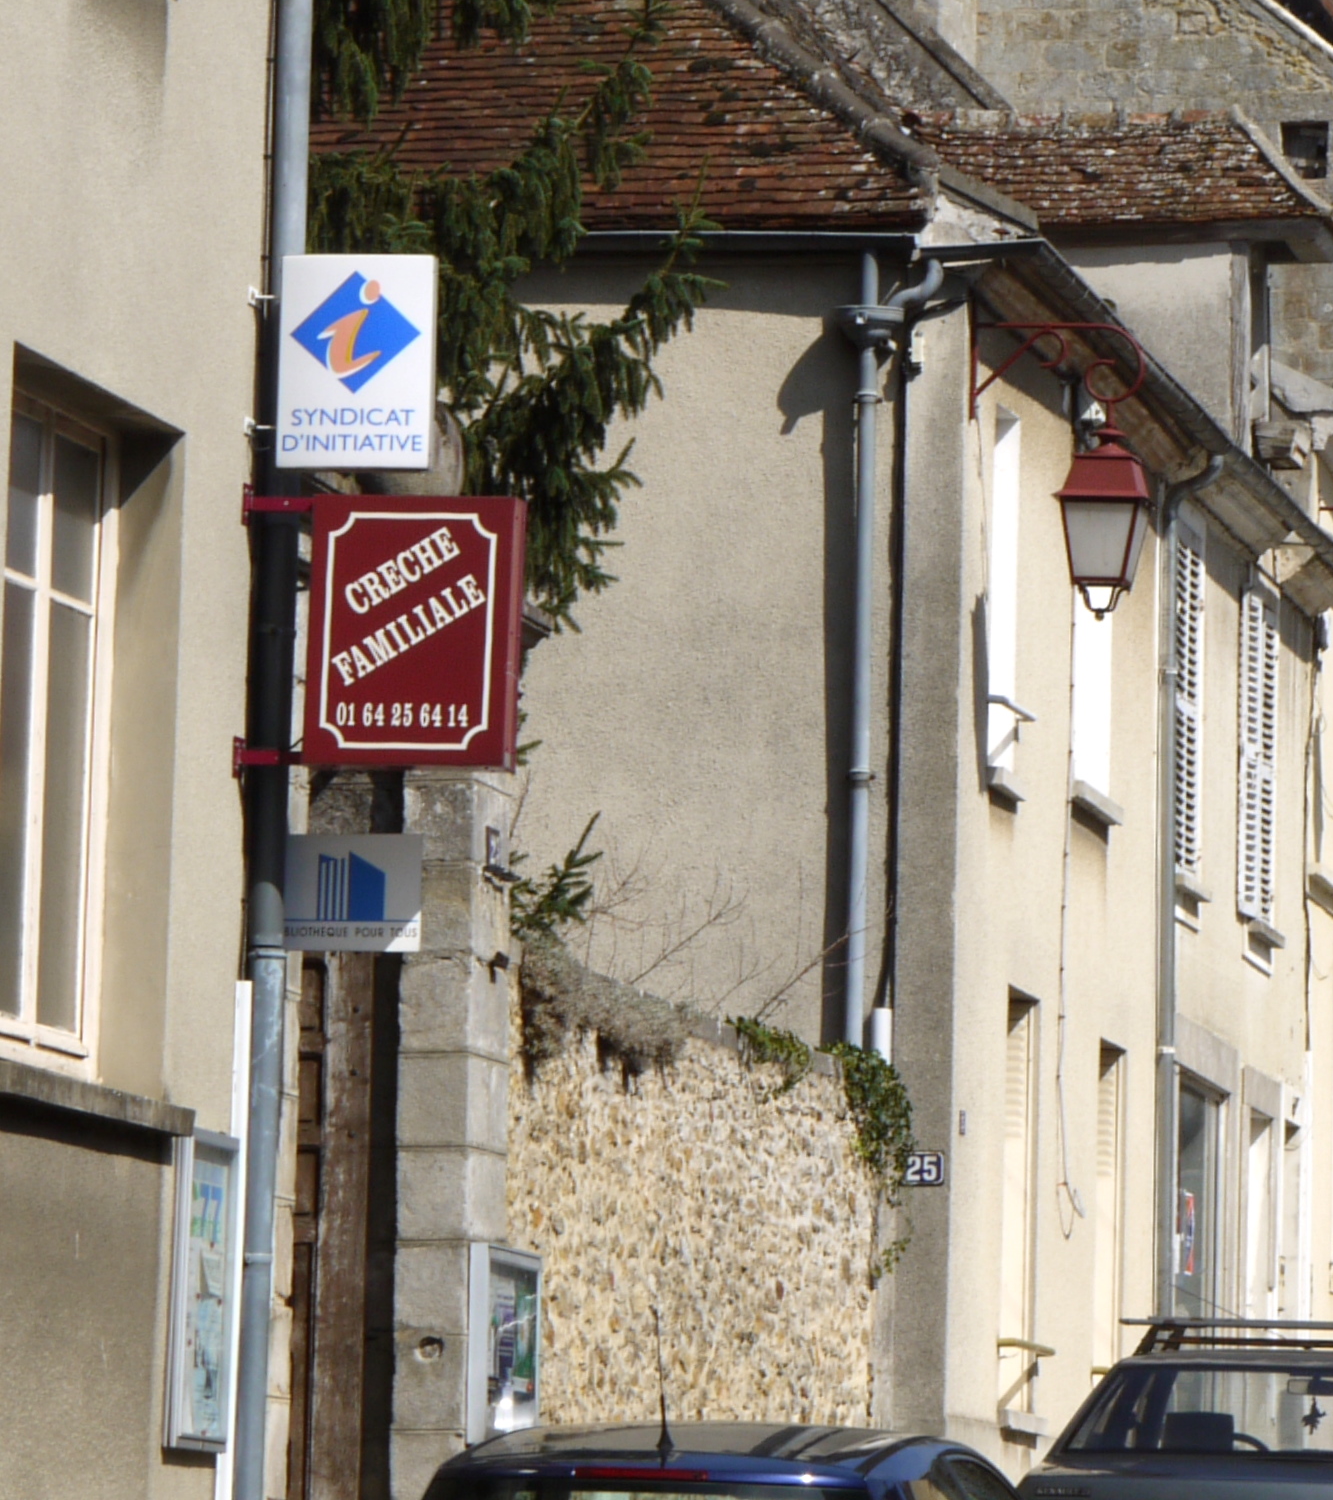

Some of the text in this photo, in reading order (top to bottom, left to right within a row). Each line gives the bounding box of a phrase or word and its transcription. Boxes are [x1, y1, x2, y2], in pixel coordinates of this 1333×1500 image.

[291, 408, 415, 427] SYNDICAT
[281, 434, 423, 452] D'INITIATIVE
[345, 526, 460, 614] CRECHE
[331, 574, 487, 687] FAMILIALE
[336, 702, 468, 728] 01 64 25 64 14
[355, 927, 384, 938] POUR
[390, 927, 417, 938] TOUS
[907, 1156, 937, 1181] 25
[201, 1183, 224, 1243] 77
